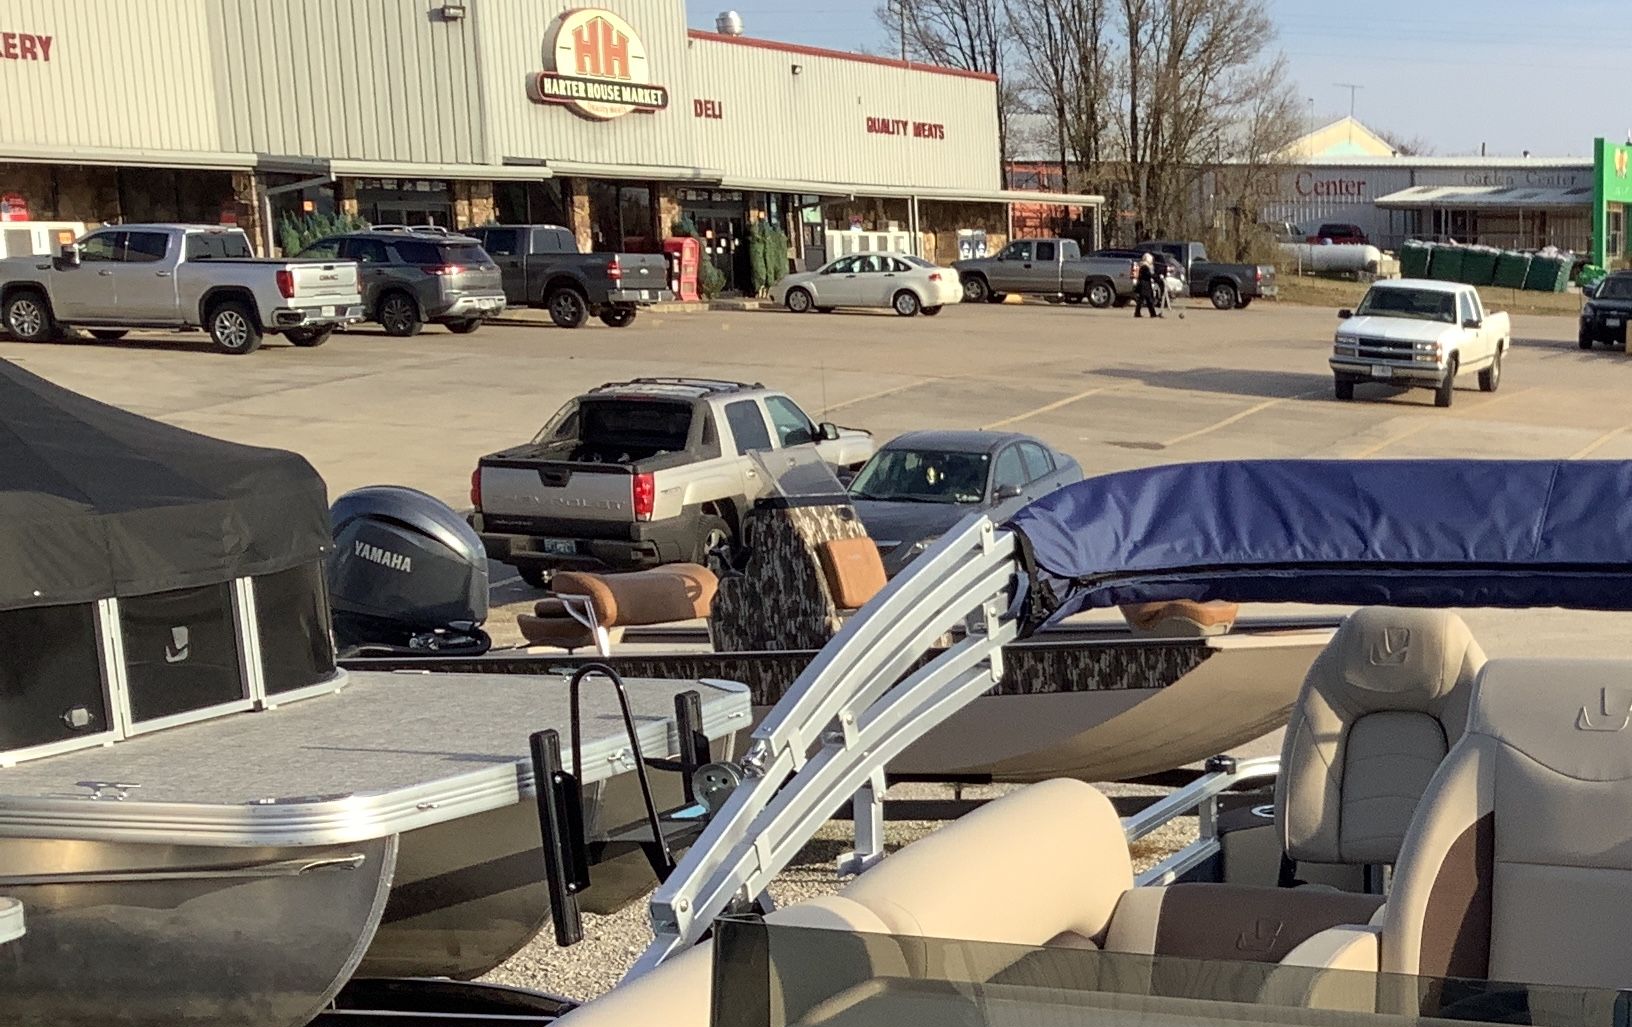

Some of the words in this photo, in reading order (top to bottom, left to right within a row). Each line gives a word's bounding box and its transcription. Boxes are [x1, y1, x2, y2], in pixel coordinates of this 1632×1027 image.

[0, 32, 52, 61] ERY
[572, 16, 630, 79] HH
[544, 78, 586, 97] HARTER
[587, 83, 621, 101] HOUSE
[621, 86, 662, 105] MARKET
[694, 99, 722, 119] DELI
[866, 117, 908, 136] QUALITY
[913, 121, 944, 139] MEATS
[1295, 171, 1366, 196] Center
[1463, 168, 1514, 186] Garden
[1526, 168, 1577, 186] Center
[355, 540, 412, 573] YAMAHA
